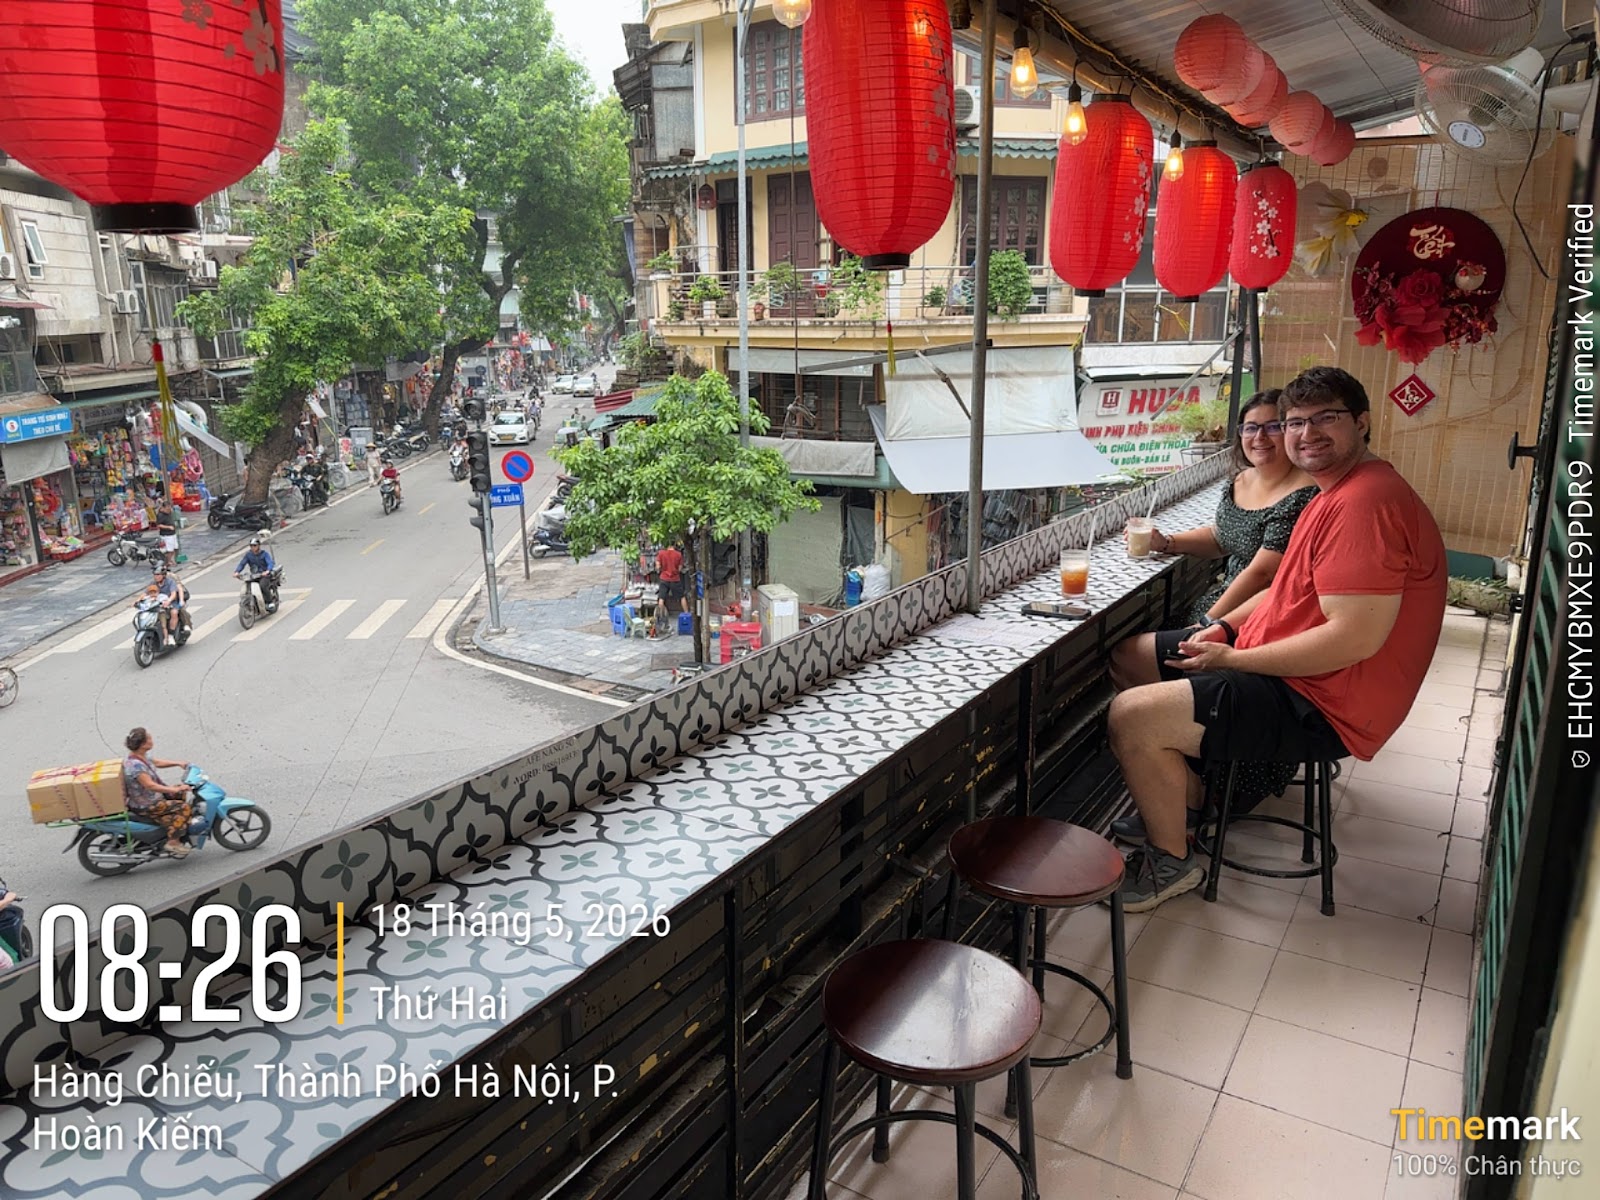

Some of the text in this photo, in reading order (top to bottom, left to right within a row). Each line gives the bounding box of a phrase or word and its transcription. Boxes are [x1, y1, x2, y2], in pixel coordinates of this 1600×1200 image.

[1104, 424, 1126, 438] PHỤ
[1110, 440, 1136, 453] CHỮA
[1139, 439, 1160, 453] ĐIỆN
